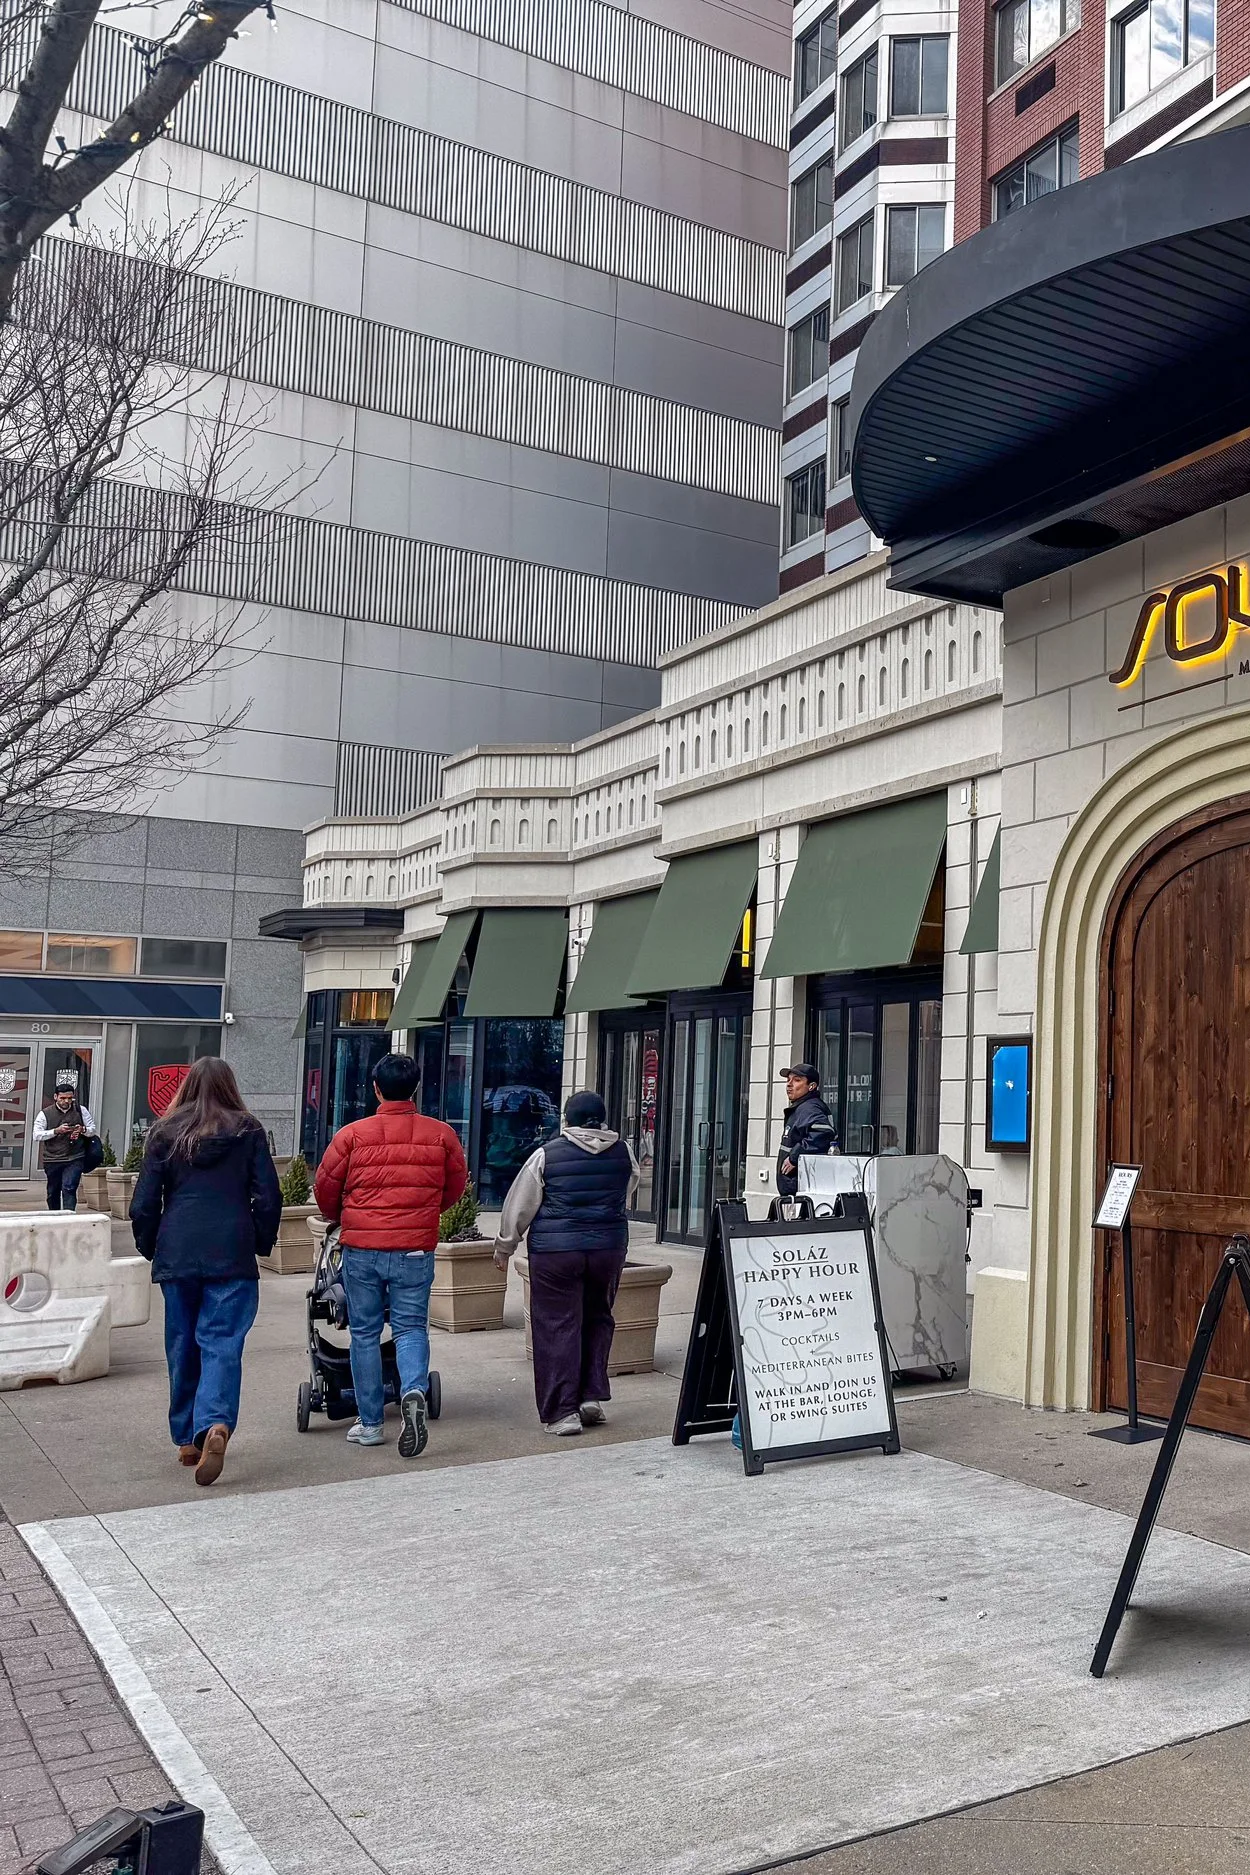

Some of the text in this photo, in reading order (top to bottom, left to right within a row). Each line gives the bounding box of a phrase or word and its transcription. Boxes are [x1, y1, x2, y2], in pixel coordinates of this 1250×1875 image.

[31, 1023, 50, 1033] 80
[772, 1245, 828, 1263] SOLÁZ
[744, 1263, 860, 1283] HAPPY HOUR
[757, 1291, 853, 1308] 7 DAYS A WEEK
[781, 1332, 840, 1347] COCKTAILS
[751, 1352, 874, 1374] MEDITERRANEAN BITES
[755, 1376, 877, 1399] WALK IN AND JOIN US
[758, 1389, 877, 1411] AT THE BAR, LOUNGE,
[770, 1401, 868, 1422] OR SWING SUITES
